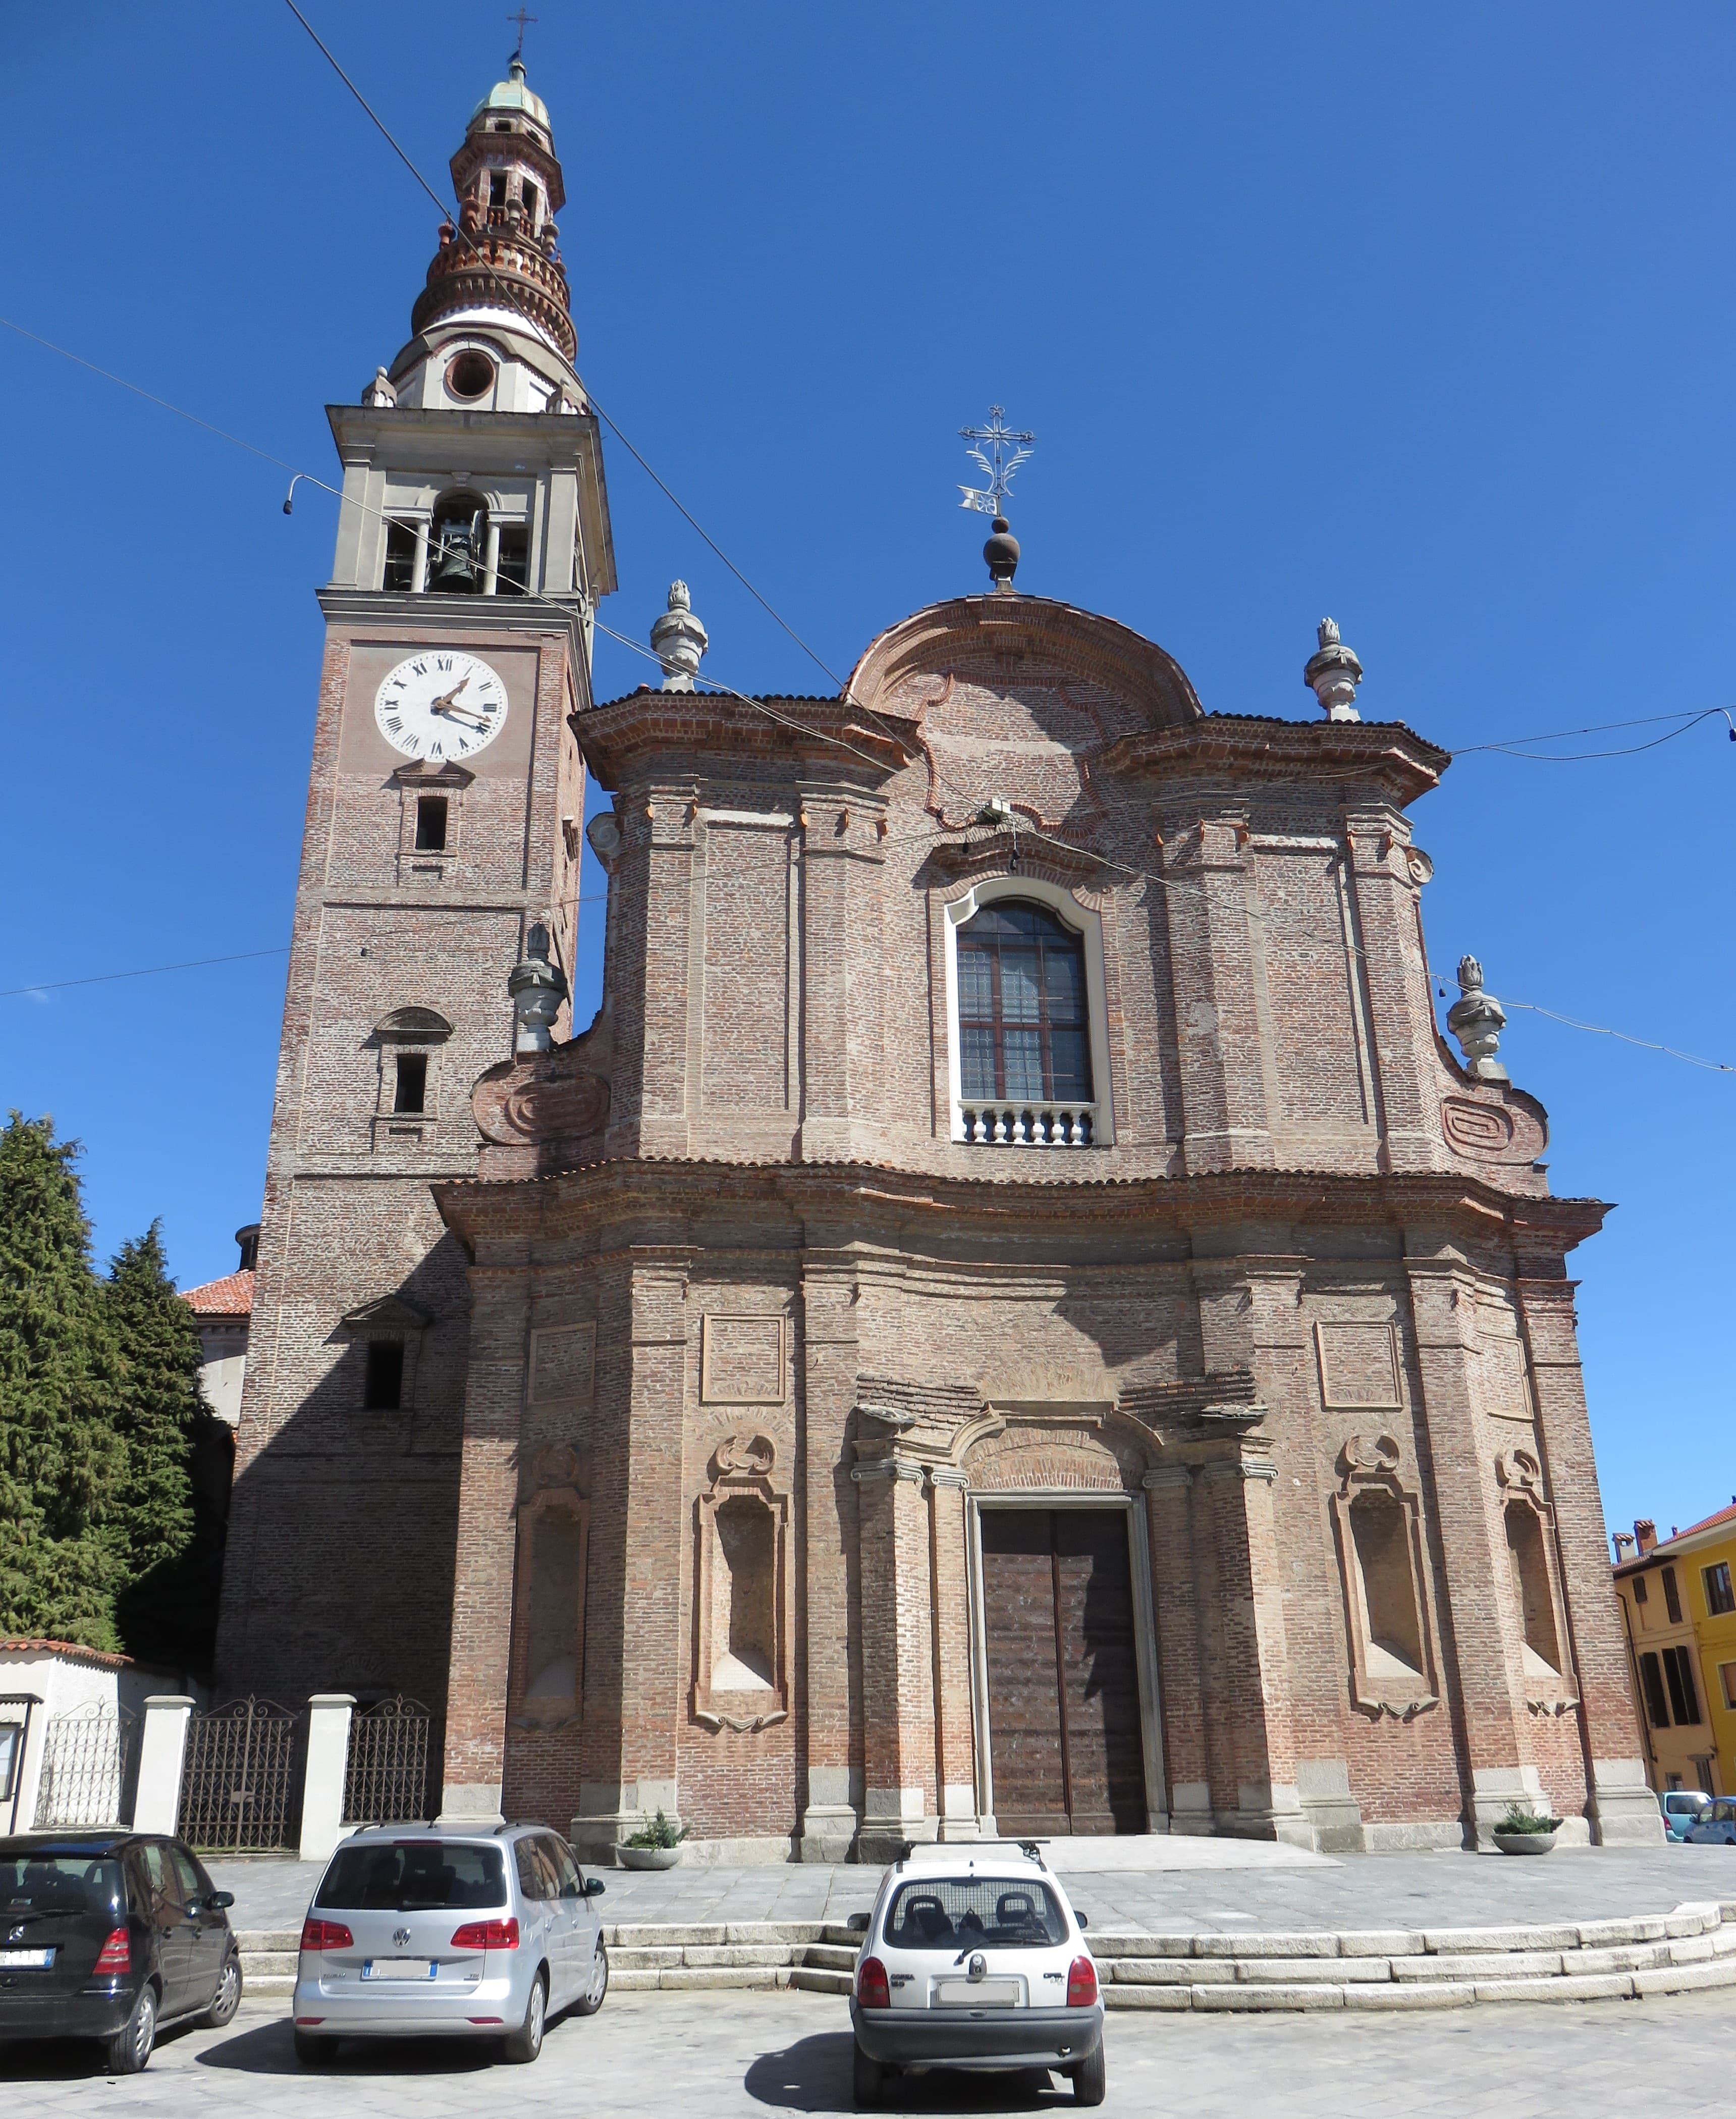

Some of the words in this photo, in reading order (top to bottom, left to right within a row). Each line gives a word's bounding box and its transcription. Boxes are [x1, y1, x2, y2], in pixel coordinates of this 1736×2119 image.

[412, 662, 427, 676] XI
[437, 659, 453, 671] XII
[393, 678, 407, 690] X
[478, 681, 493, 692] II
[384, 700, 399, 710] IX
[483, 704, 497, 712] III
[386, 716, 404, 735] VIII
[403, 733, 419, 753] VII
[431, 741, 442, 755] VI
[459, 737, 469, 750] V
